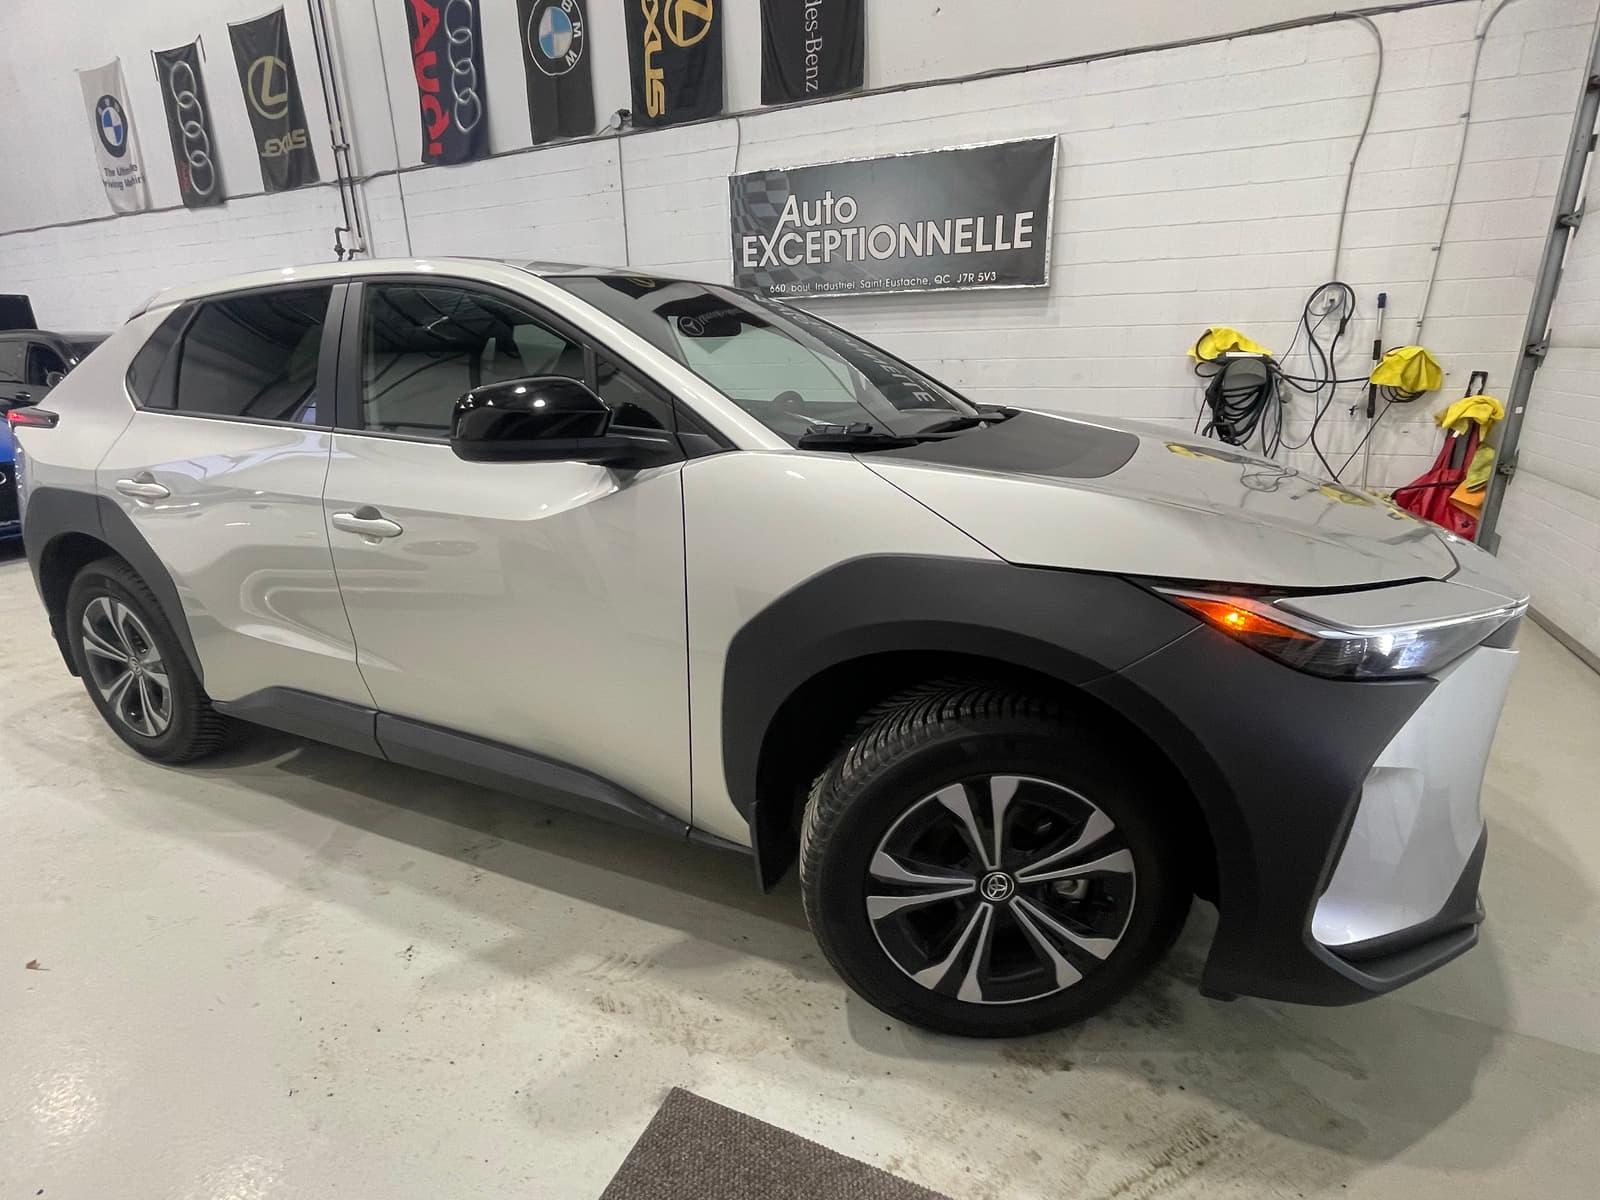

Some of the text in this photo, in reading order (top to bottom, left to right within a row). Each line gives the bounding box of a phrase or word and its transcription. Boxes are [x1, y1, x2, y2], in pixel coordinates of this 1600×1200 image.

[775, 190, 858, 227] Auto
[742, 210, 1034, 269] EXCEPTIONNELLE
[934, 274, 951, 285] QC
[957, 272, 975, 284] J7R
[977, 271, 997, 282] 5V3
